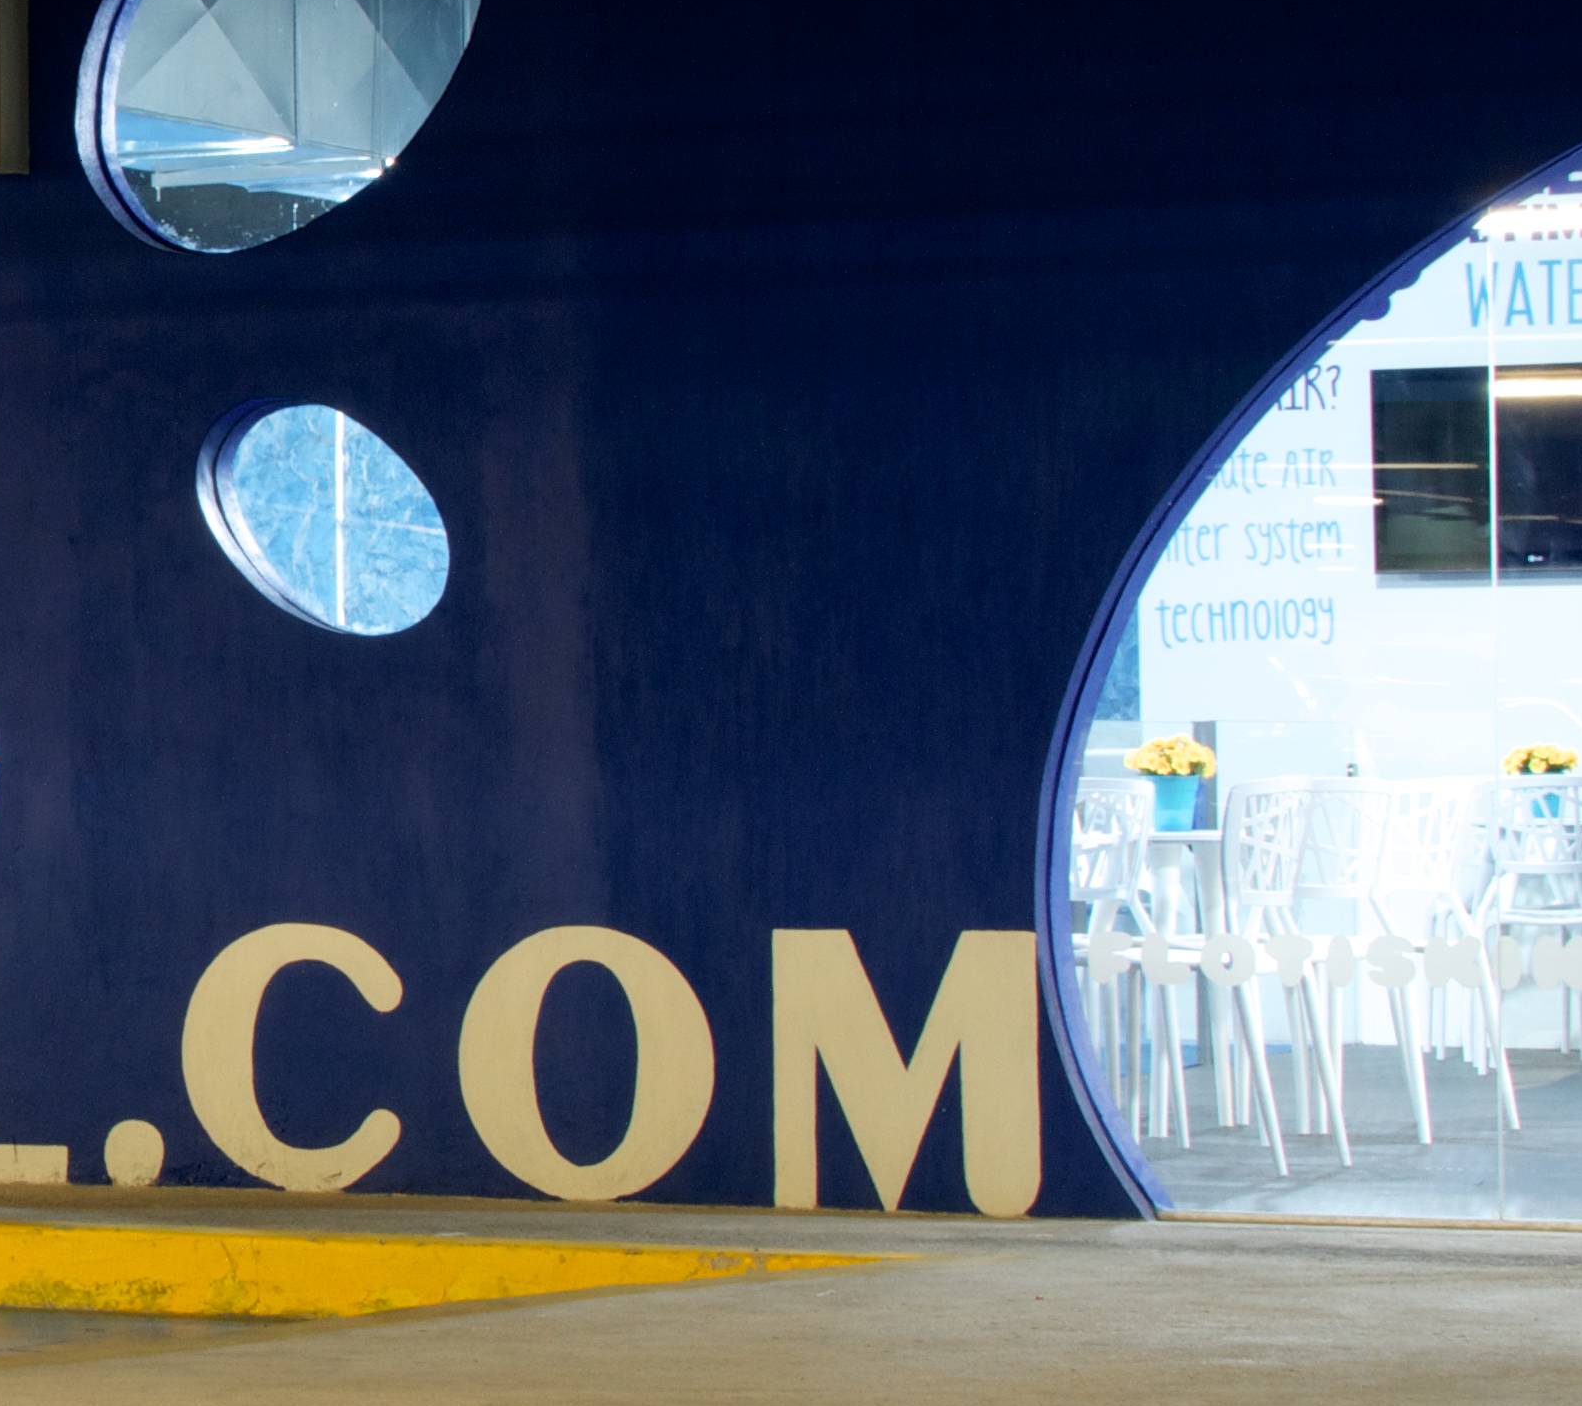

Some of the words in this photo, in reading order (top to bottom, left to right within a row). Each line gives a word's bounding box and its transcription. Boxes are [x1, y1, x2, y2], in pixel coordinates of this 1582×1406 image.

[1281, 448, 1337, 489] AIR
[1244, 517, 1344, 567] system
[1154, 596, 1335, 649] technology
